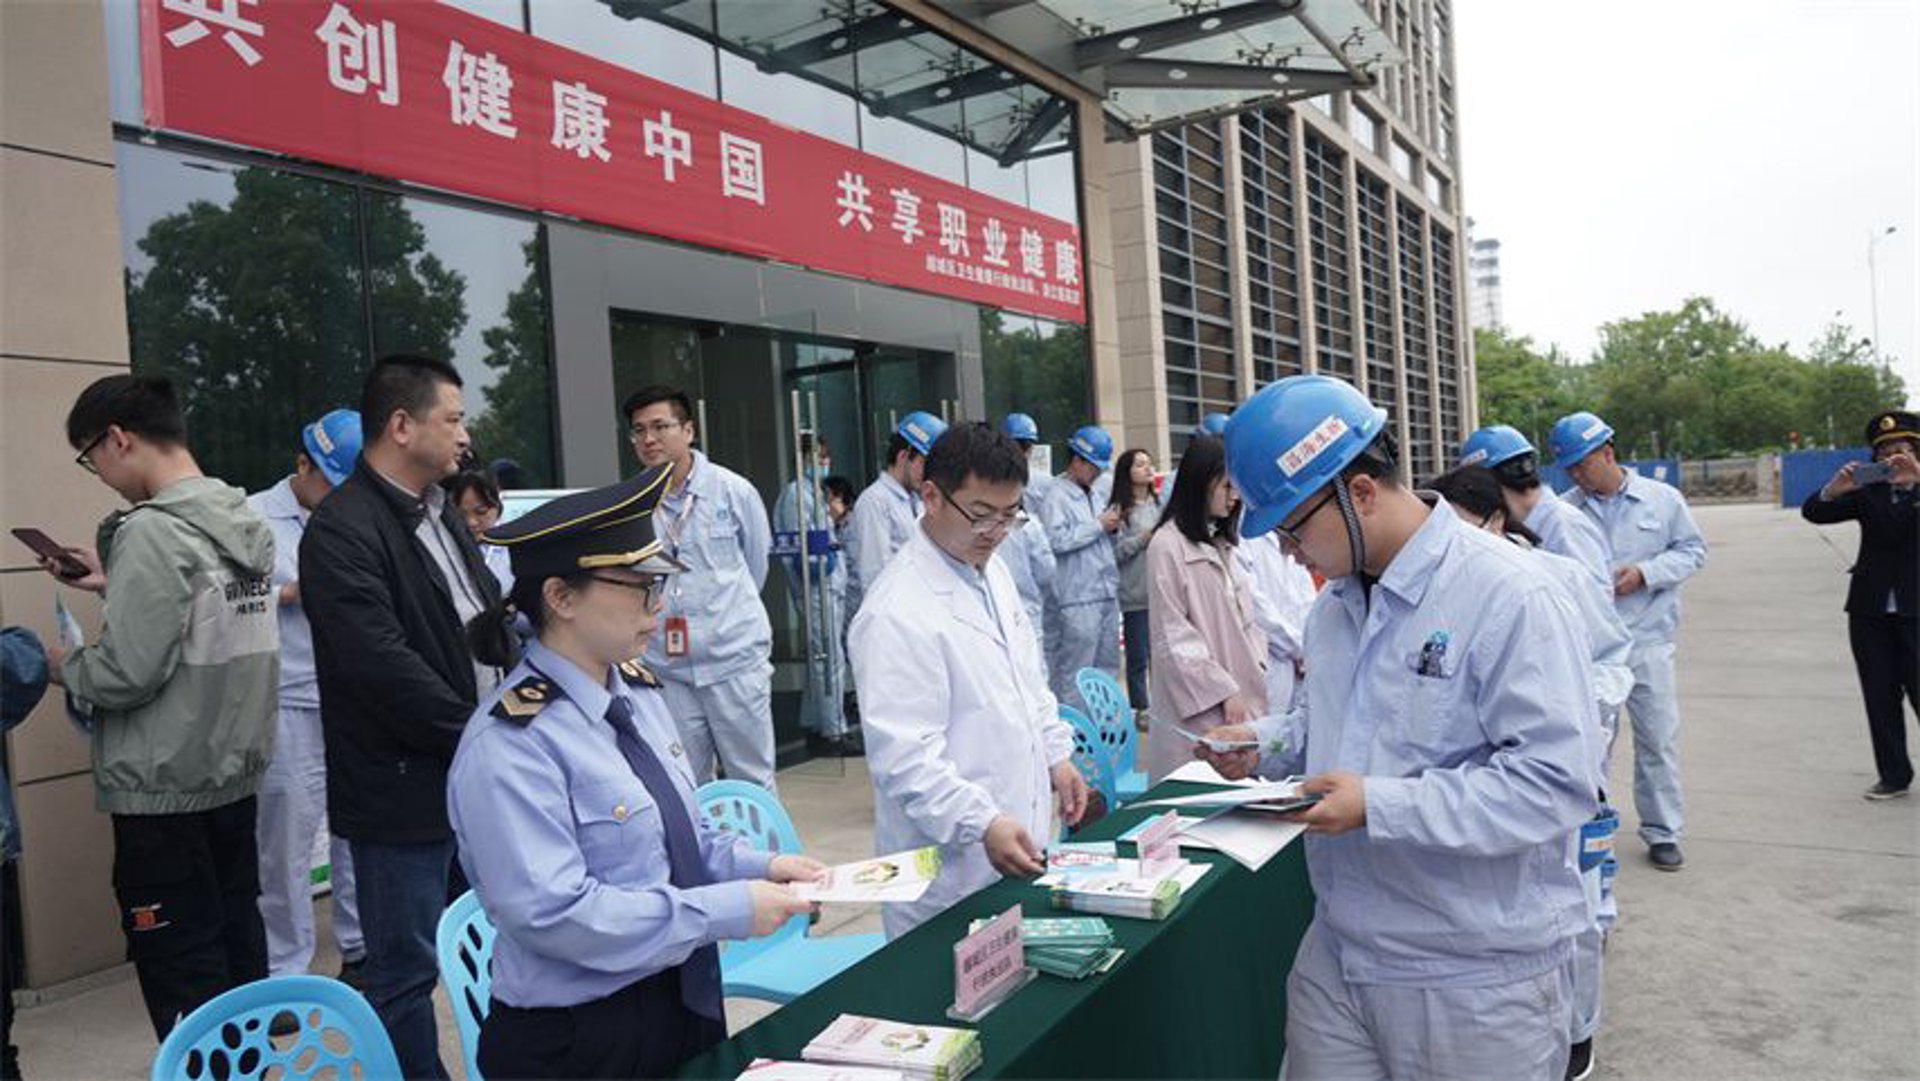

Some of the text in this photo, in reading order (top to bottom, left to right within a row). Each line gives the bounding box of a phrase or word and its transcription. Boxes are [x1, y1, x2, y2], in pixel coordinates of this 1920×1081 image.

[164, 0, 1080, 286] 共创健康中国 共享职业健康
